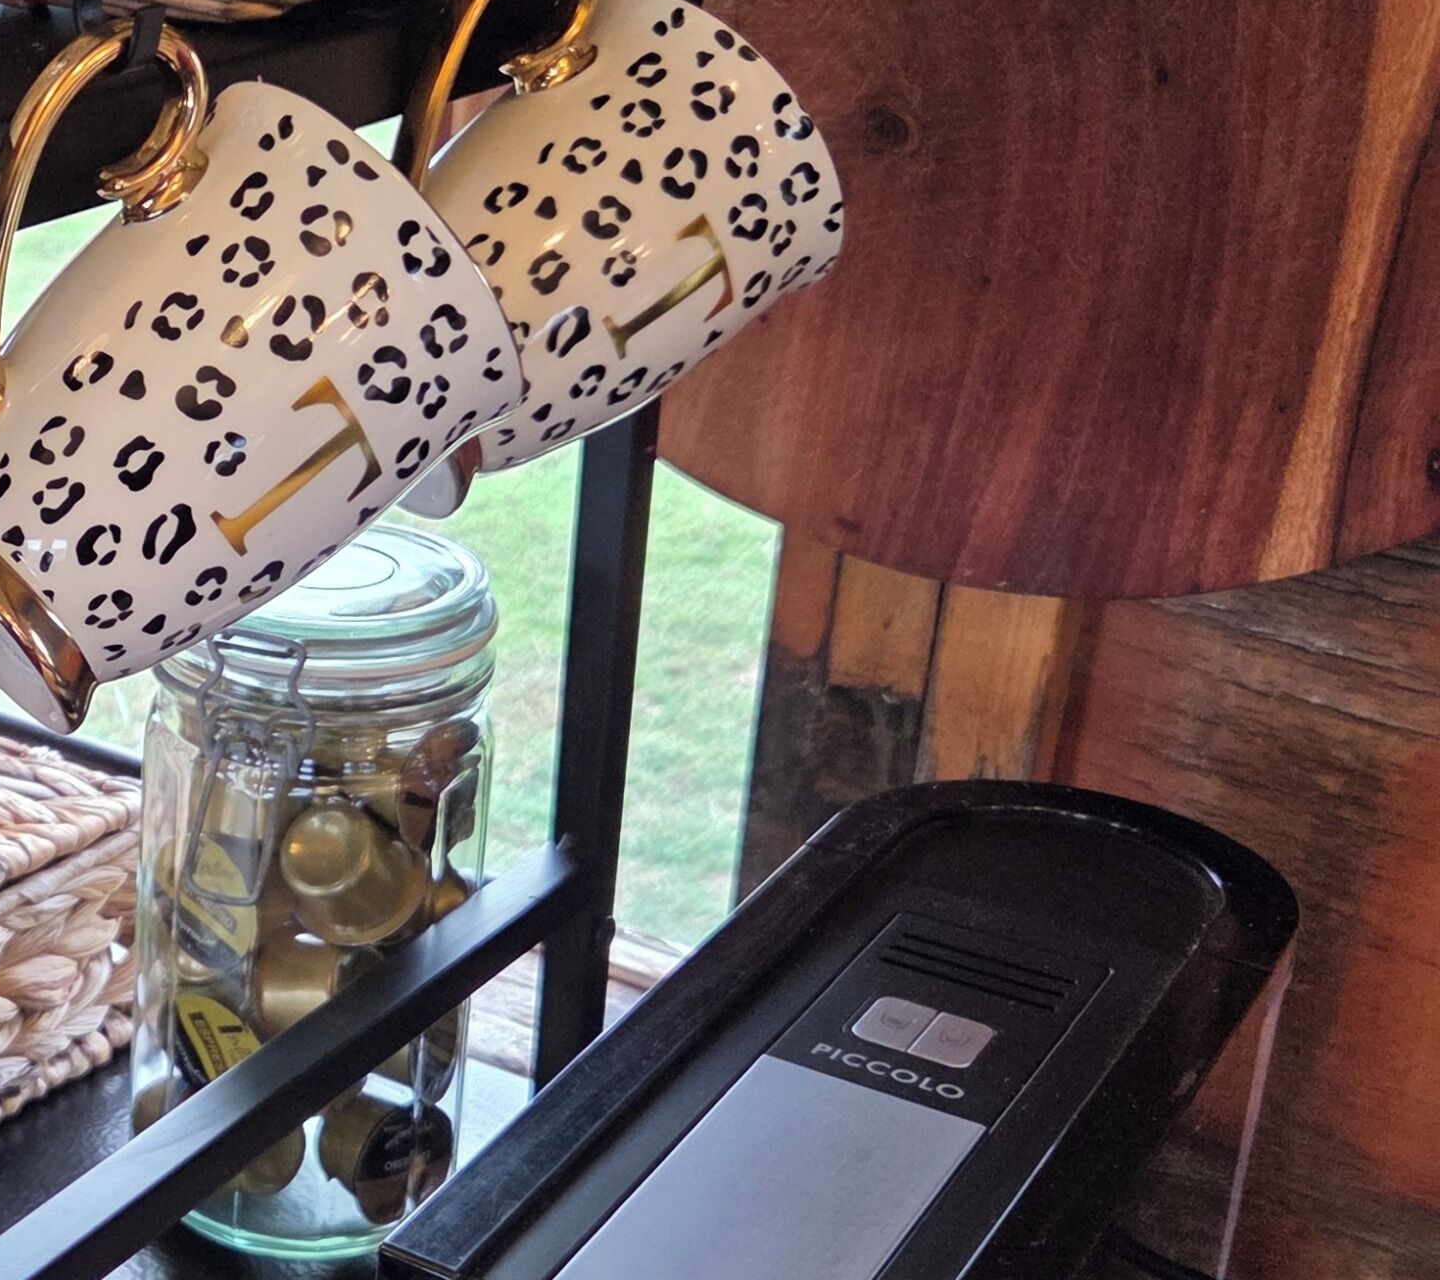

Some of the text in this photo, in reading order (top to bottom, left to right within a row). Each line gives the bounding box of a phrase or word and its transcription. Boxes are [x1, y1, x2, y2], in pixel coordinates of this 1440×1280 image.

[601, 214, 734, 359] T
[210, 376, 382, 558] T
[811, 1042, 965, 1099] PICCOLO
